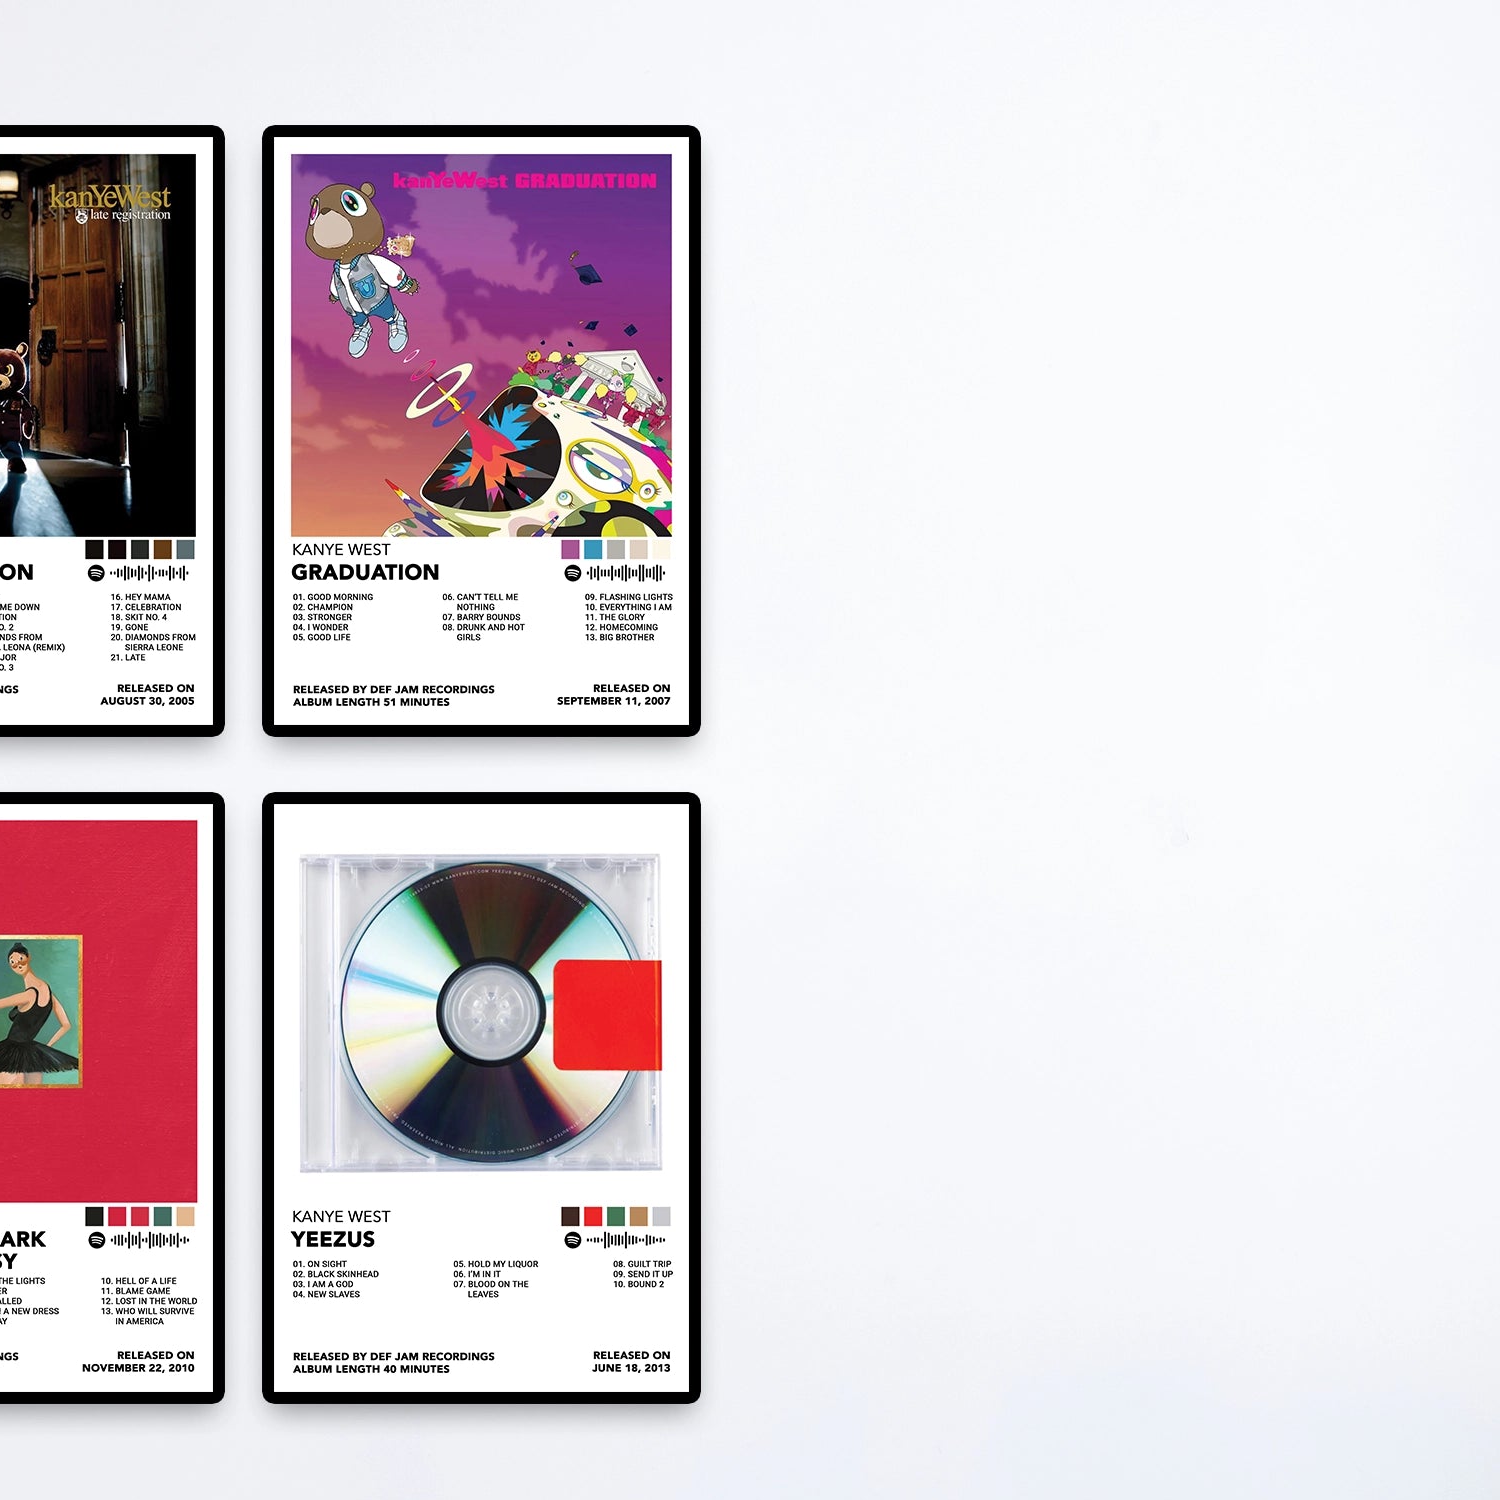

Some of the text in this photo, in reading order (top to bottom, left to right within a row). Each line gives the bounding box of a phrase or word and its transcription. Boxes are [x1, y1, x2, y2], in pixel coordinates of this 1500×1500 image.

[515, 173, 657, 188] GRADUATION
[90, 208, 171, 222] late registration
[292, 543, 392, 556] KANYE WEST
[292, 564, 438, 580] GRADUATION
[110, 593, 172, 601] 16. HEY MAMA
[442, 592, 455, 601] 06.
[483, 593, 504, 601] TELL
[505, 593, 519, 601] ME
[456, 603, 496, 611] NOTHING
[585, 603, 598, 611] 10.
[599, 602, 652, 611] EVERYTHING
[658, 603, 673, 611] AM
[442, 613, 521, 622] 07. BARRY BOUNDS
[100, 696, 195, 707] AUGUST 30, 2005
[556, 696, 671, 707] SEPTEMBER 11, 2007
[292, 1209, 392, 1223] KANYE WEST
[291, 1231, 374, 1247] YEEZUS
[292, 1260, 348, 1268] 01. ON SIGHT
[612, 1259, 672, 1268] 08. GUILT TRIP
[453, 1270, 466, 1278] 06.
[482, 1270, 492, 1278] IN
[493, 1270, 502, 1278] IT
[613, 1280, 665, 1288] 10. BOUND 2
[467, 1290, 500, 1299] LEAVES
[117, 1350, 195, 1360] RELEASED ON
[82, 1363, 195, 1374] NOVEMBER 22, 2010
[591, 1363, 671, 1374] JUNE 18, 2013
